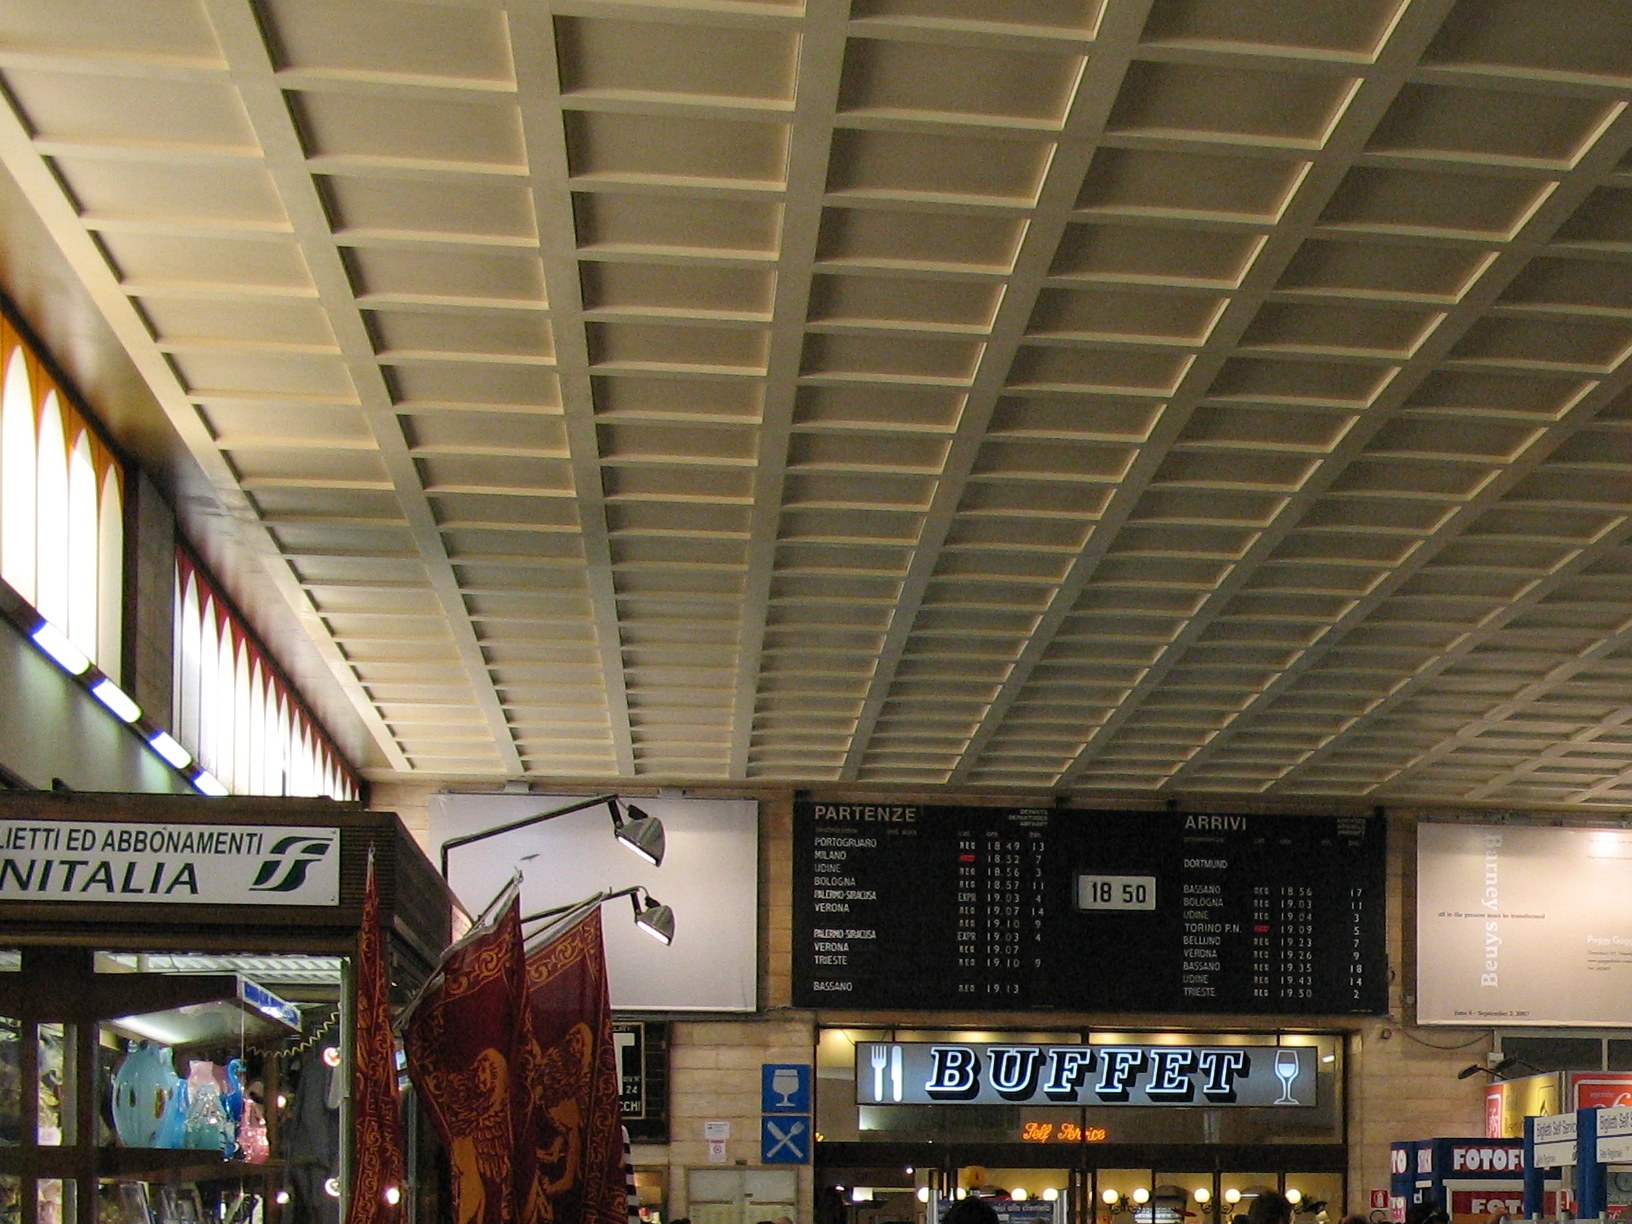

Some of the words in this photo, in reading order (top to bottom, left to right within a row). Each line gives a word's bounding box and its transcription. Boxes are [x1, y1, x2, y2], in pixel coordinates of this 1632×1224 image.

[815, 805, 917, 822] PARTENZE
[1184, 815, 1247, 831] ARRIVI
[67, 828, 97, 851] ED
[101, 830, 264, 855] ABBONAMENTI
[814, 838, 877, 848] PORTOGRUARO
[1032, 842, 1045, 852] 13
[814, 851, 847, 860] MILANO
[1035, 855, 1042, 864] 7
[1183, 858, 1228, 869] DORTMUND
[0, 858, 200, 895] NITALIA
[814, 864, 841, 873] UDINE
[1035, 868, 1042, 877] 3
[1481, 833, 1502, 911] Barney
[814, 877, 856, 887] BOLOGNA
[1032, 881, 1044, 890] 11
[1092, 881, 1112, 903] 18
[1122, 884, 1147, 903] 50
[1183, 884, 1221, 895] BASSANO
[1350, 888, 1363, 897] 17
[1035, 895, 1042, 903] 4
[1183, 897, 1224, 907] BOLOGNA
[1350, 901, 1363, 910] 11
[814, 903, 850, 913] VERONA
[1031, 907, 1045, 916] 14
[1183, 910, 1209, 920] UDINE
[1353, 913, 1360, 923] 3
[1034, 919, 1042, 929] 9
[1185, 923, 1222, 933] TORINO
[1353, 926, 1360, 936] 5
[1034, 933, 1042, 942] 4
[1183, 935, 1221, 945] BELLUNO
[1353, 938, 1360, 948] 7
[814, 942, 850, 952] VERONA
[1183, 949, 1218, 958] VERONA
[1353, 951, 1360, 961] 9
[1480, 921, 1502, 988] Beuys
[814, 955, 848, 965] TRIESTE
[1034, 958, 1042, 968] 9
[1183, 962, 1221, 971] BASSANO
[1350, 964, 1363, 974] 18
[813, 981, 853, 992] BASSANO
[1183, 974, 1209, 984] UDINE
[1350, 977, 1363, 986] 14
[1183, 987, 1216, 997] TRIESTE
[1353, 989, 1360, 999] 2
[925, 1046, 1250, 1103] BUFFET
[1022, 1122, 1052, 1143] Self
[1453, 1148, 1525, 1171] FOTOF
[1471, 1199, 1525, 1214] FOT
